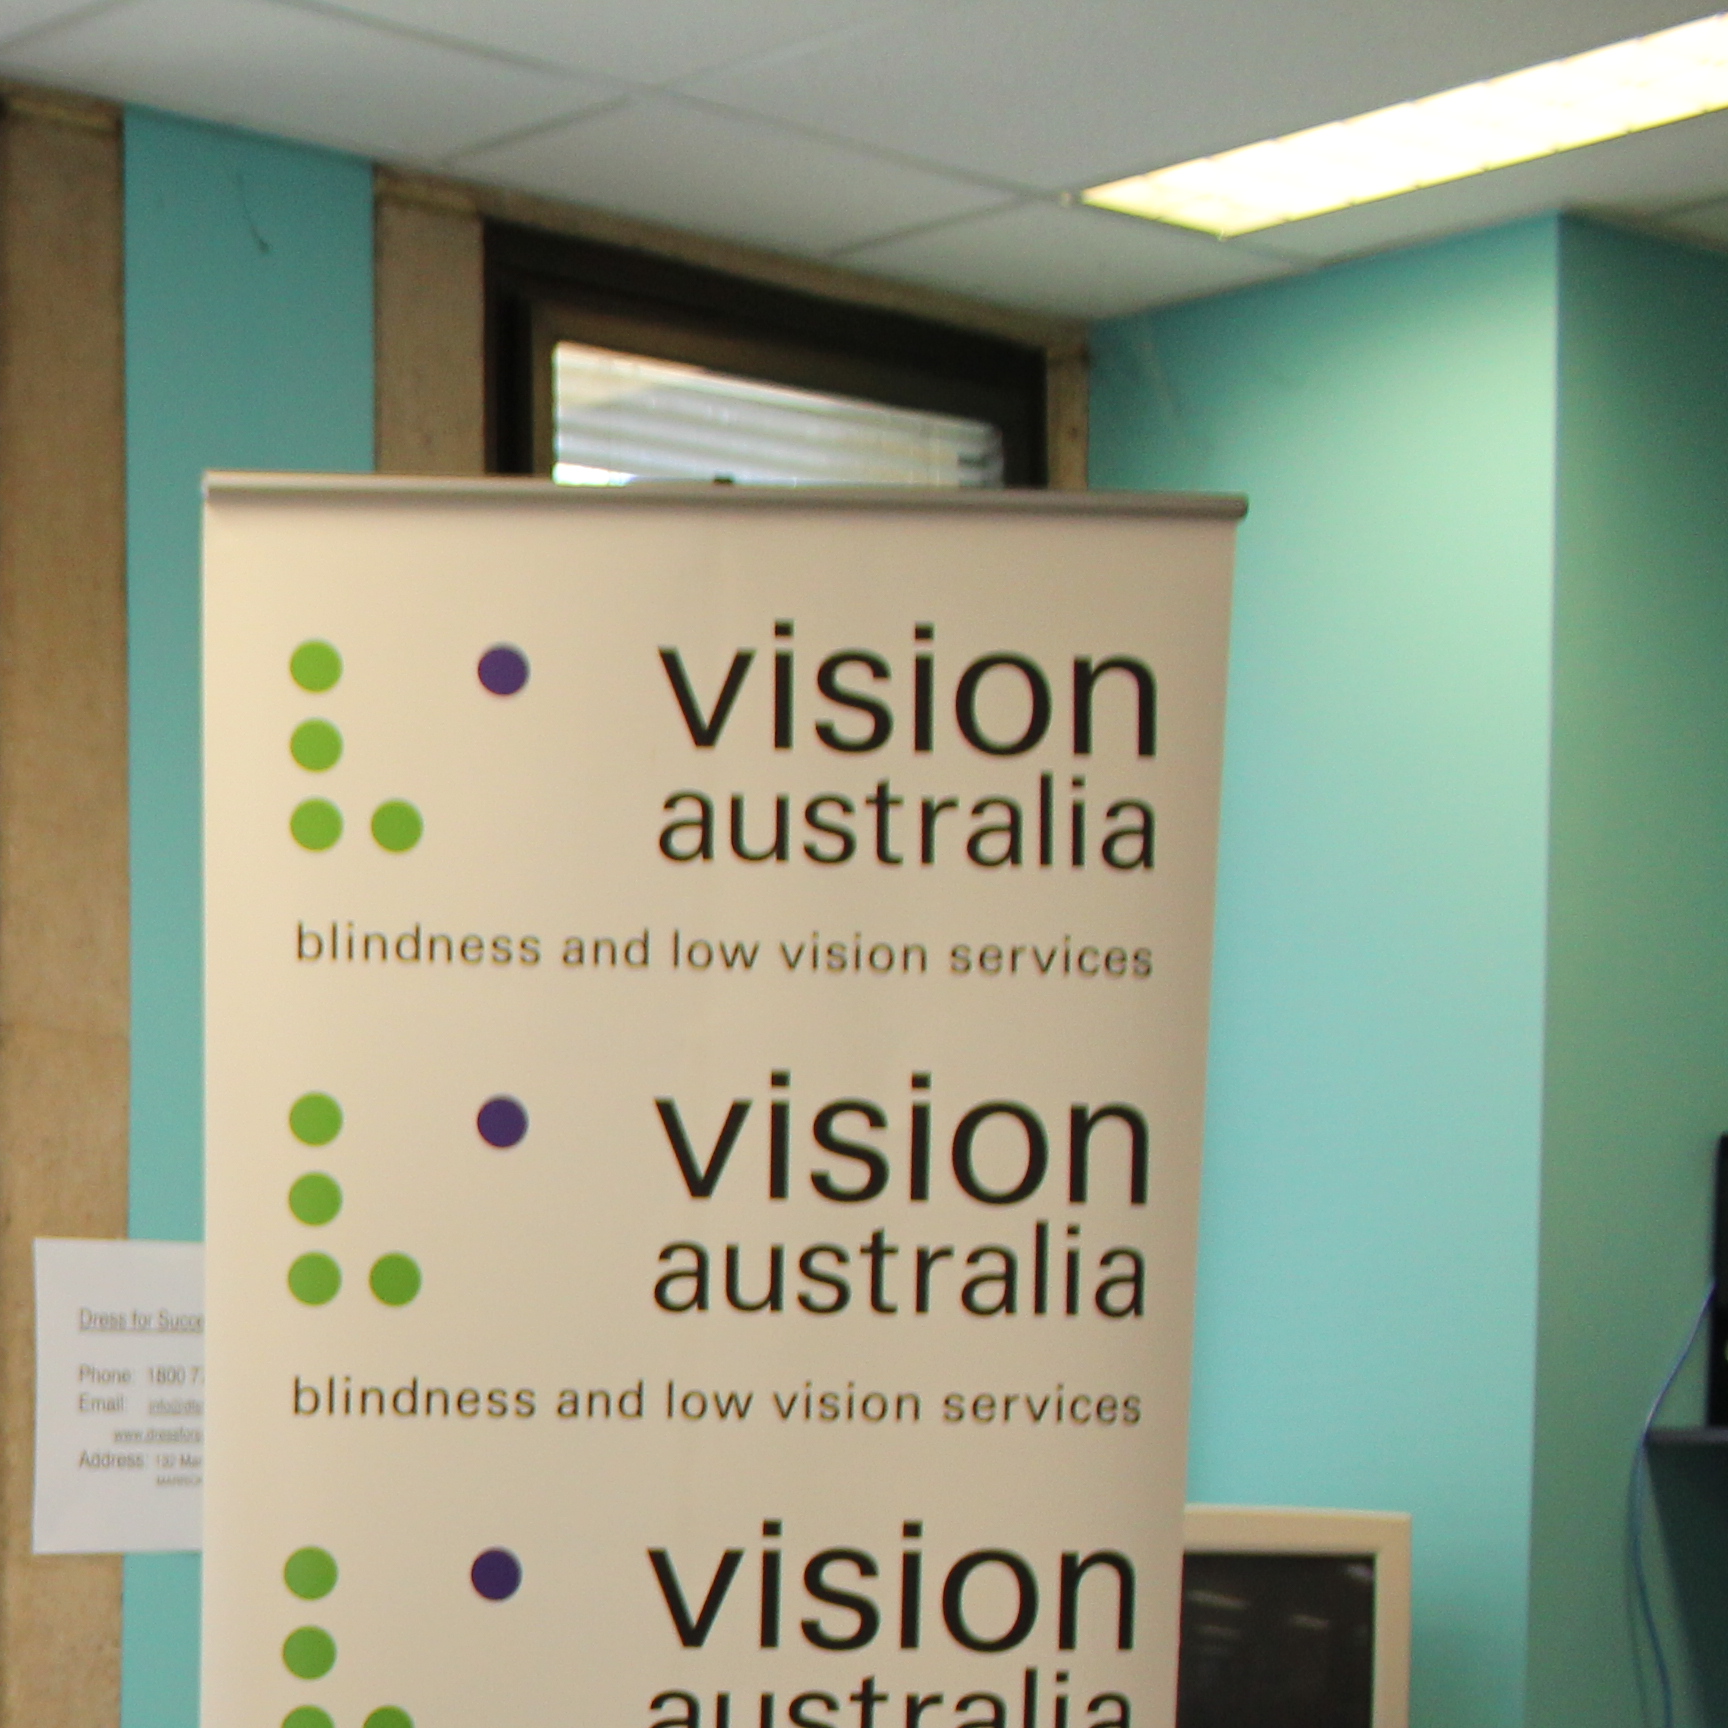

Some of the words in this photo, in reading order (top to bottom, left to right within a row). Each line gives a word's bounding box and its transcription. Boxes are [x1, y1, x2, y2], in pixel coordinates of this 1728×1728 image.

[659, 622, 1157, 758] vision
[659, 773, 1155, 871] australia
[297, 922, 541, 965] blindness
[562, 928, 649, 967] and
[673, 930, 759, 970] low
[781, 932, 927, 972] vision
[950, 936, 1152, 978] services
[655, 1070, 1149, 1206] vision
[653, 1221, 1145, 1319] australia
[294, 1376, 536, 1418] blindness
[557, 1380, 643, 1418] and
[667, 1380, 753, 1419] low
[773, 1381, 920, 1421] vision
[944, 1386, 1141, 1425] services
[648, 1520, 1136, 1654] vision
